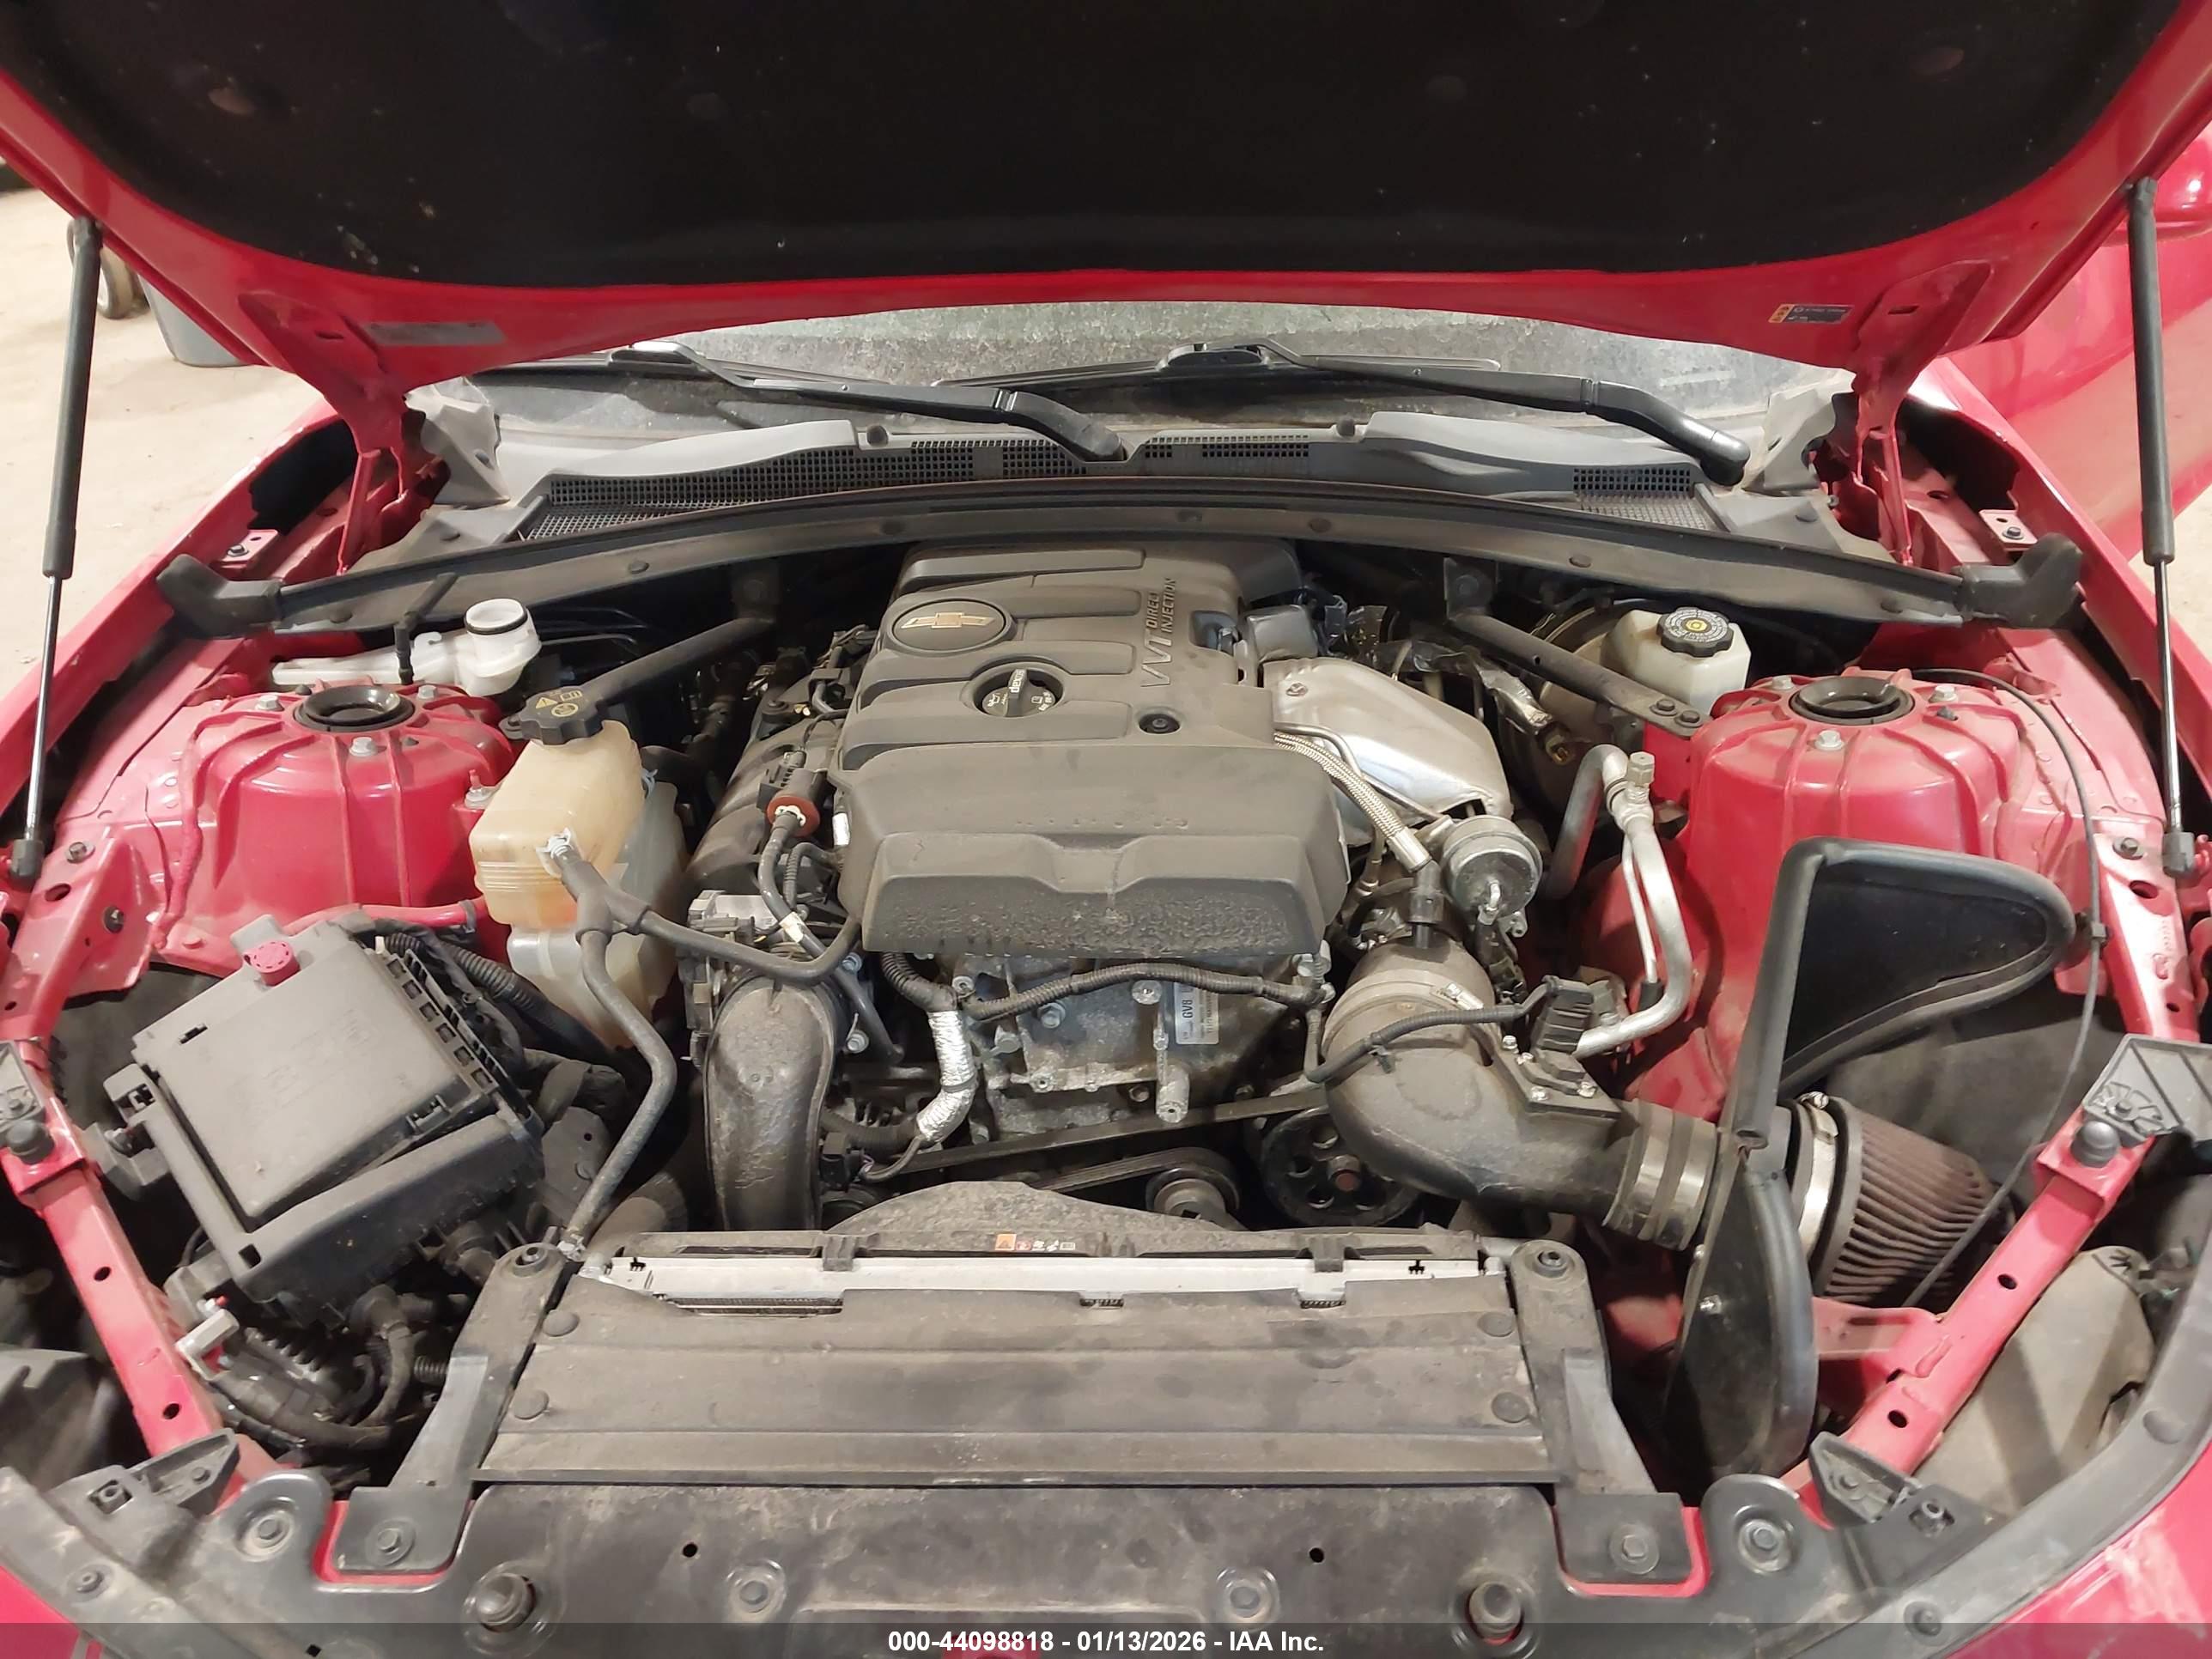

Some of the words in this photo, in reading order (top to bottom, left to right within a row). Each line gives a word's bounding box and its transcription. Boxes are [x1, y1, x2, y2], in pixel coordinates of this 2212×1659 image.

[1145, 591, 1159, 629] DIRECT
[1161, 577, 1176, 634] INJECTION
[1140, 629, 1172, 688] VVT
[1182, 1000, 1194, 1018] GV8
